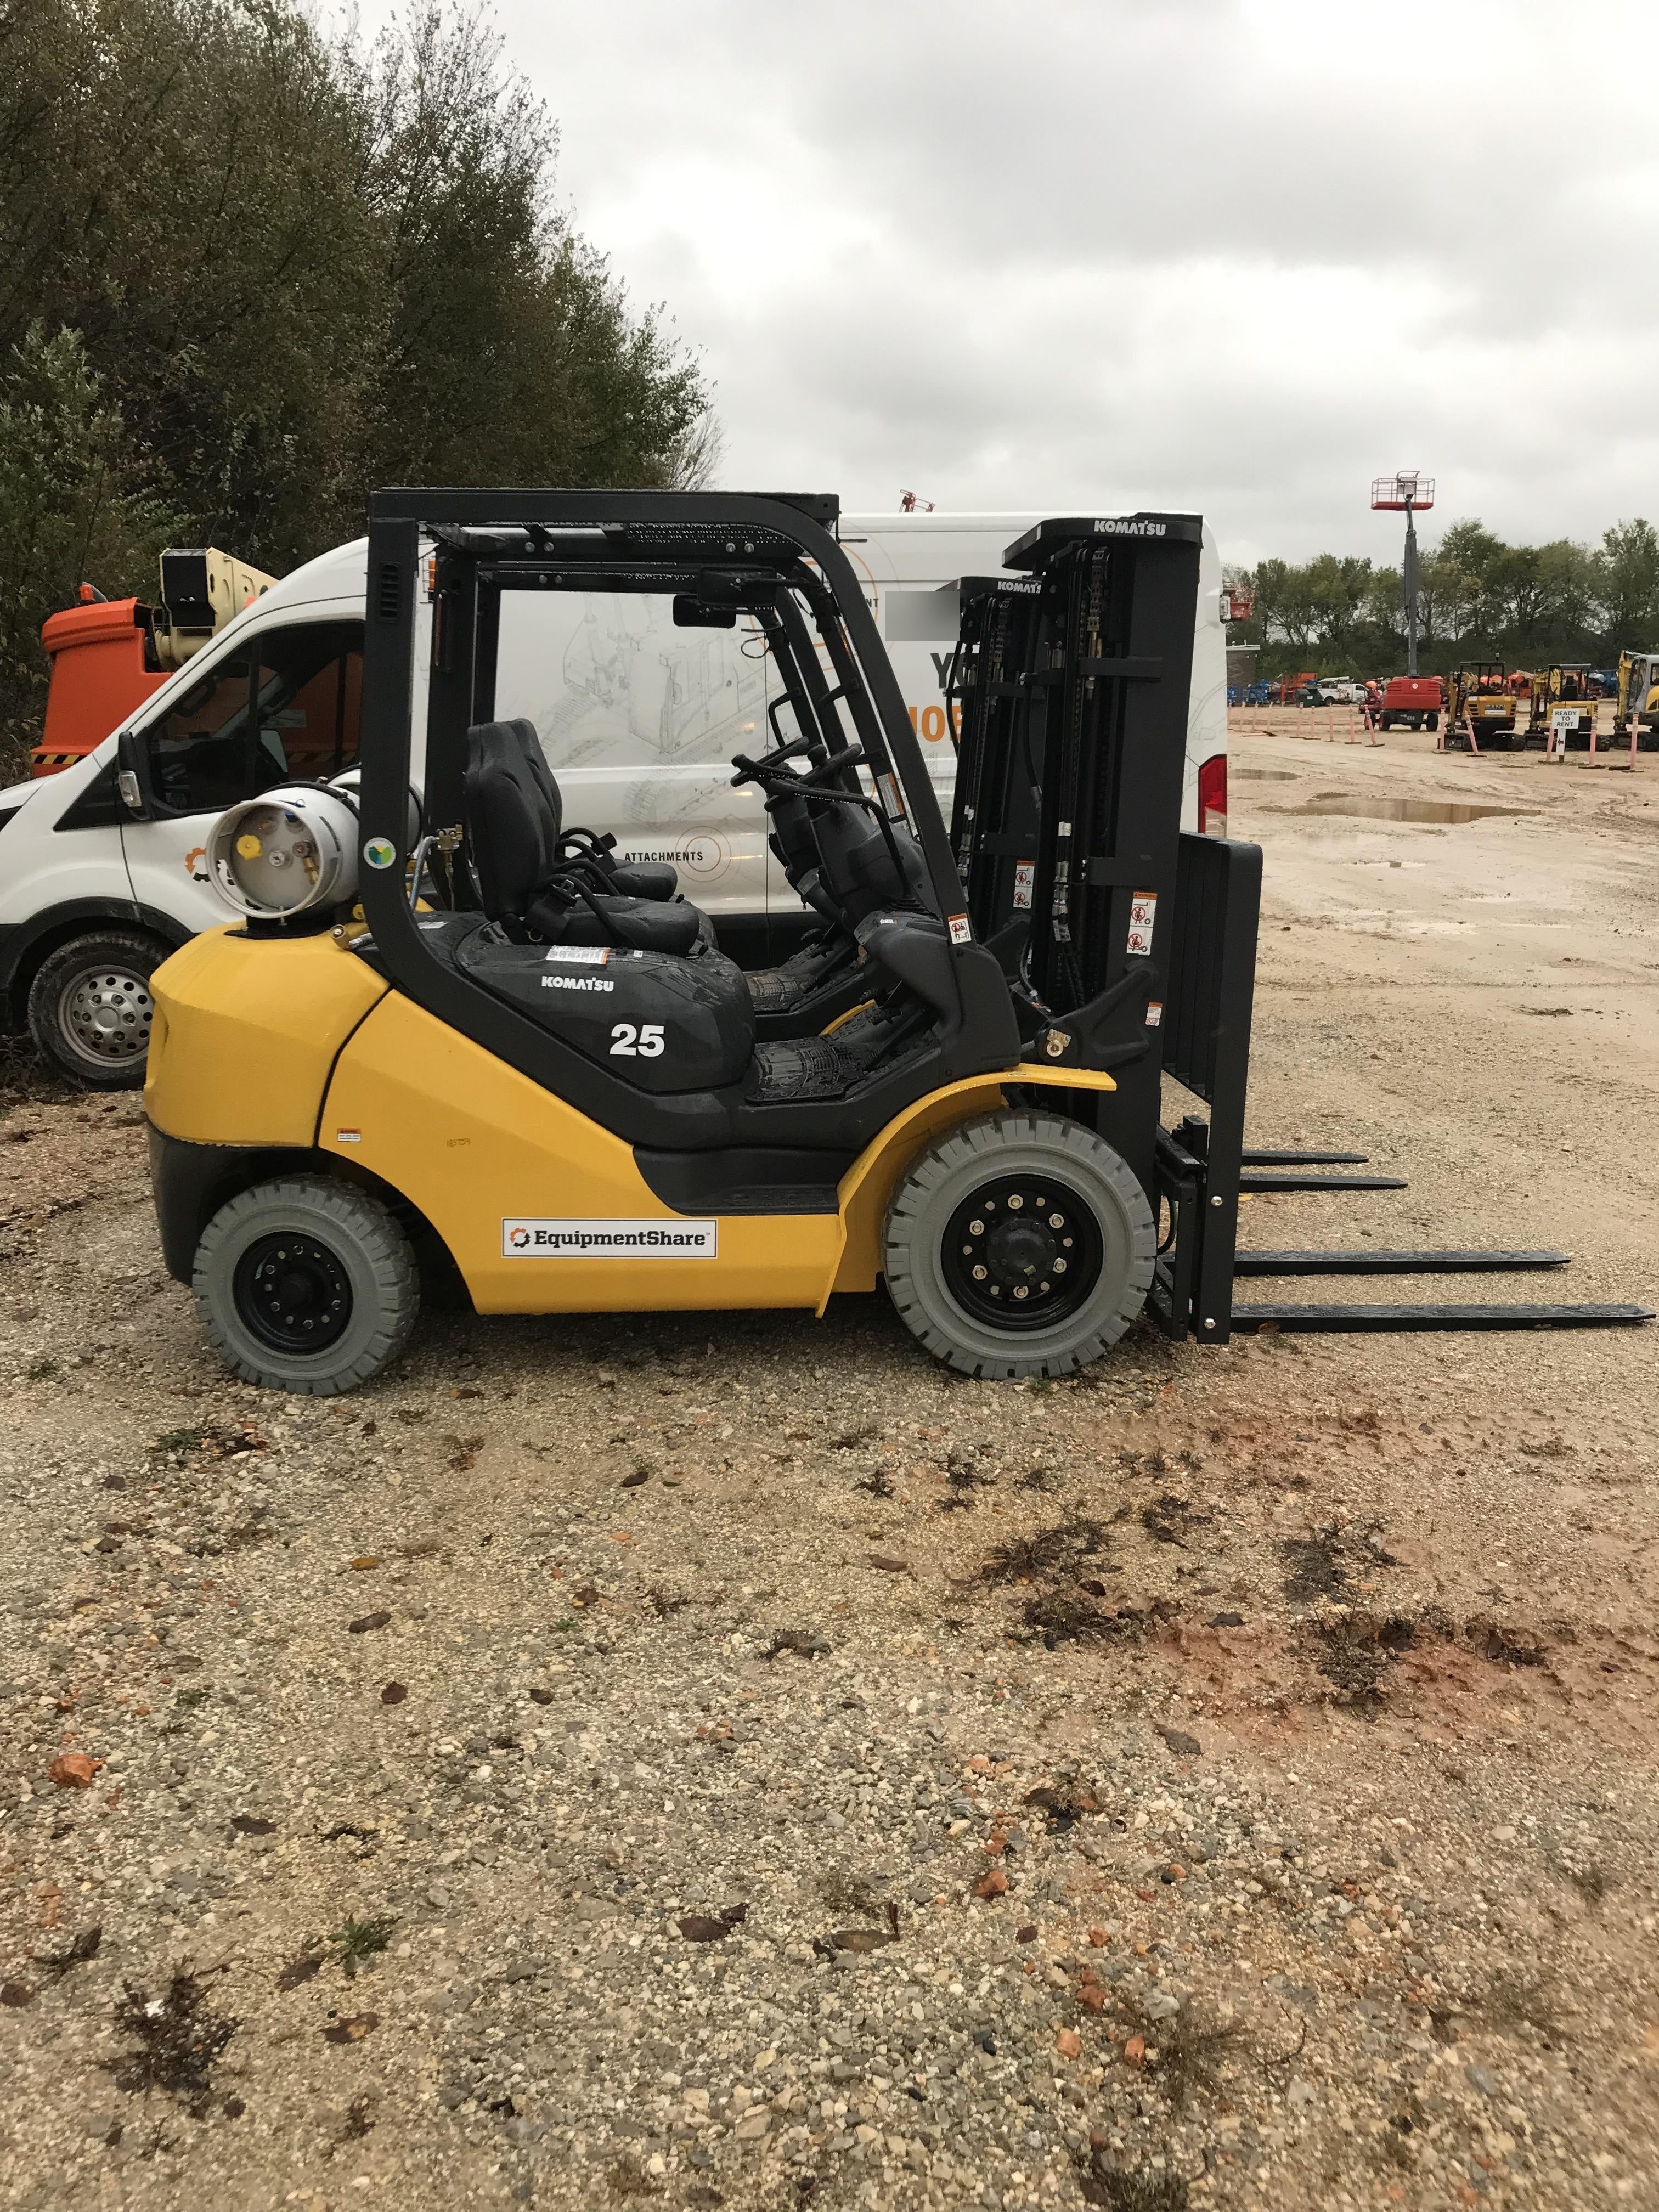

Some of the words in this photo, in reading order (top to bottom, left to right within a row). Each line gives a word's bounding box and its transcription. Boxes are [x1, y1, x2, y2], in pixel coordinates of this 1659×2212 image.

[1094, 520, 1166, 536] KOMATSU
[997, 581, 1041, 594] KOMATS
[624, 851, 703, 862] ATTACHMENTS
[541, 975, 614, 992] KOMATSU
[609, 1023, 665, 1057] 25
